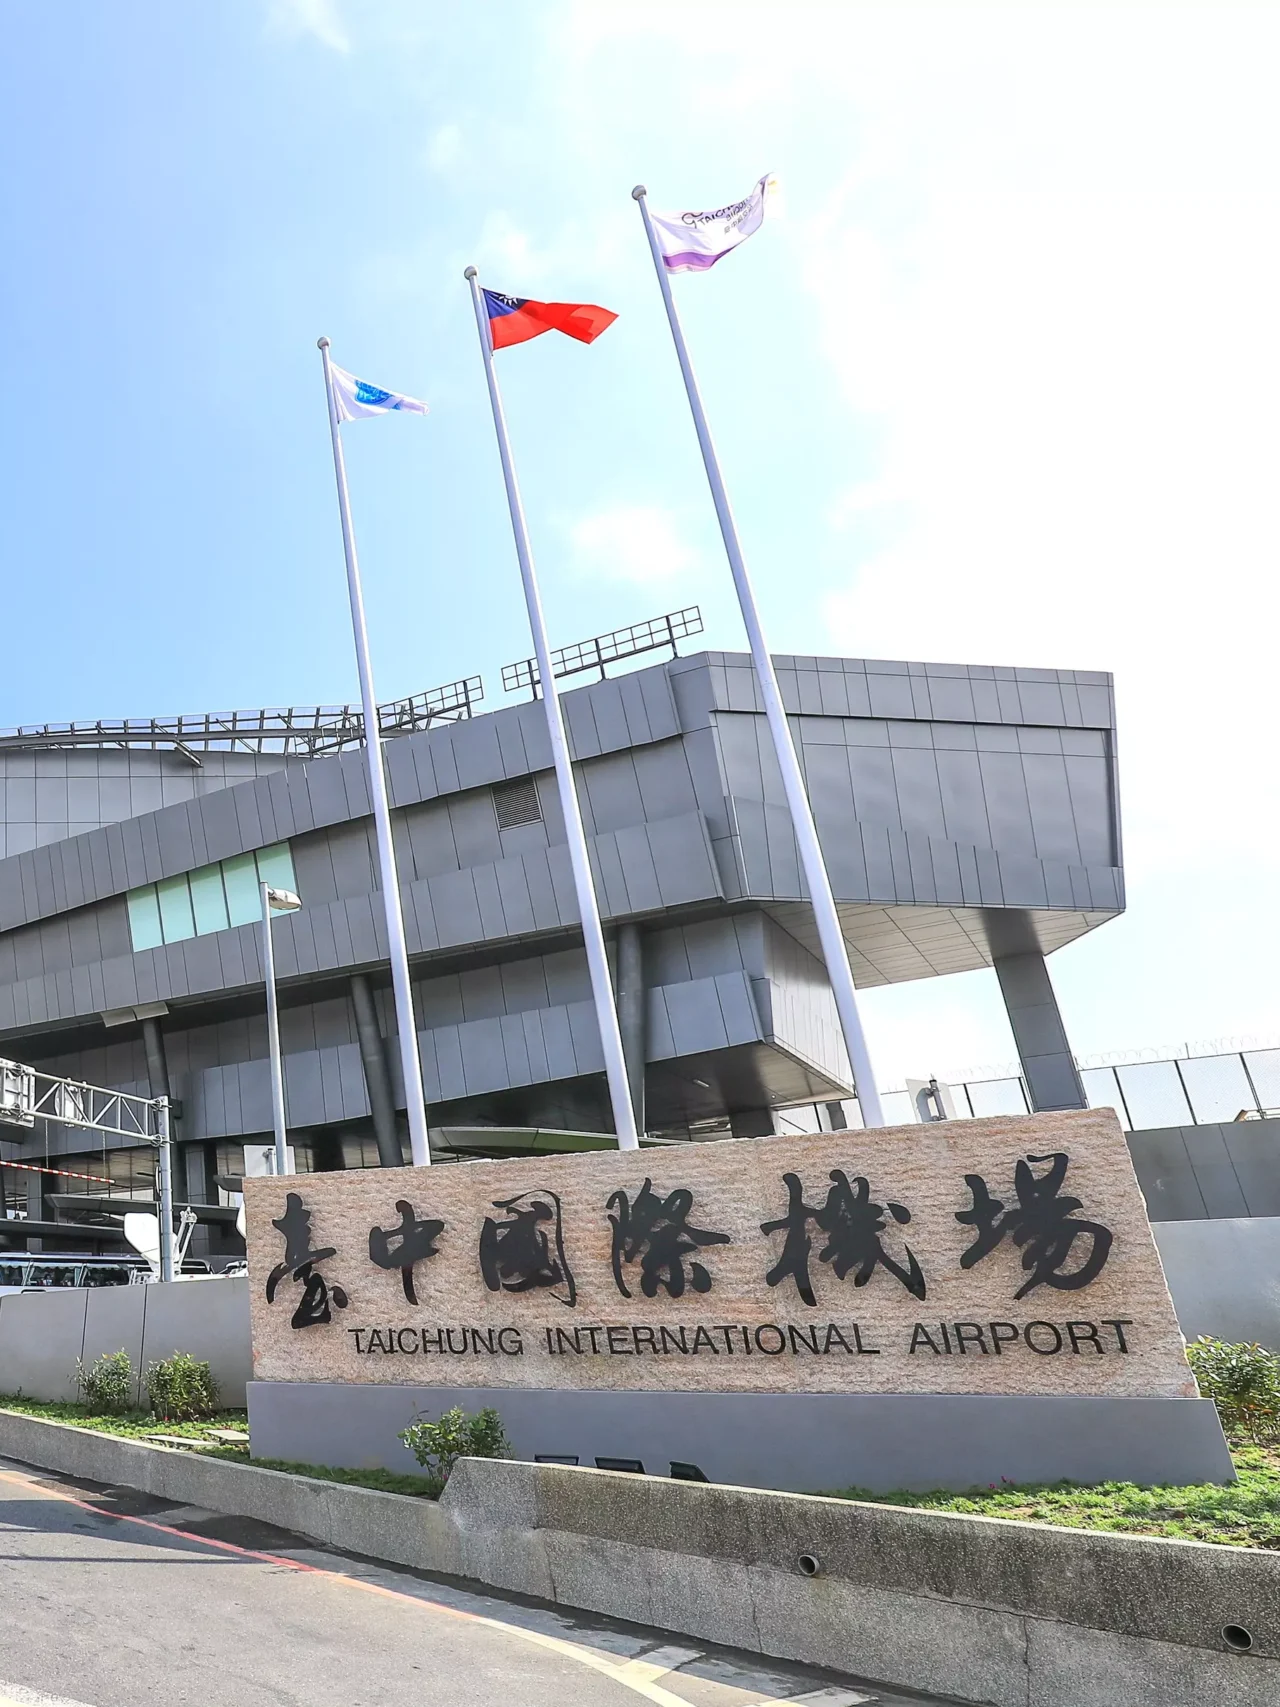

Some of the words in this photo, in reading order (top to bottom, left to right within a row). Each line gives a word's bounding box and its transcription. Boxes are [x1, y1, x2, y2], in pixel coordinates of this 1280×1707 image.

[265, 1152, 1114, 1329] 臺中國際機場
[348, 1328, 524, 1356] TAICHUNG
[546, 1322, 881, 1356] INTERNATIONAL
[909, 1318, 1133, 1356] AIRPORT
